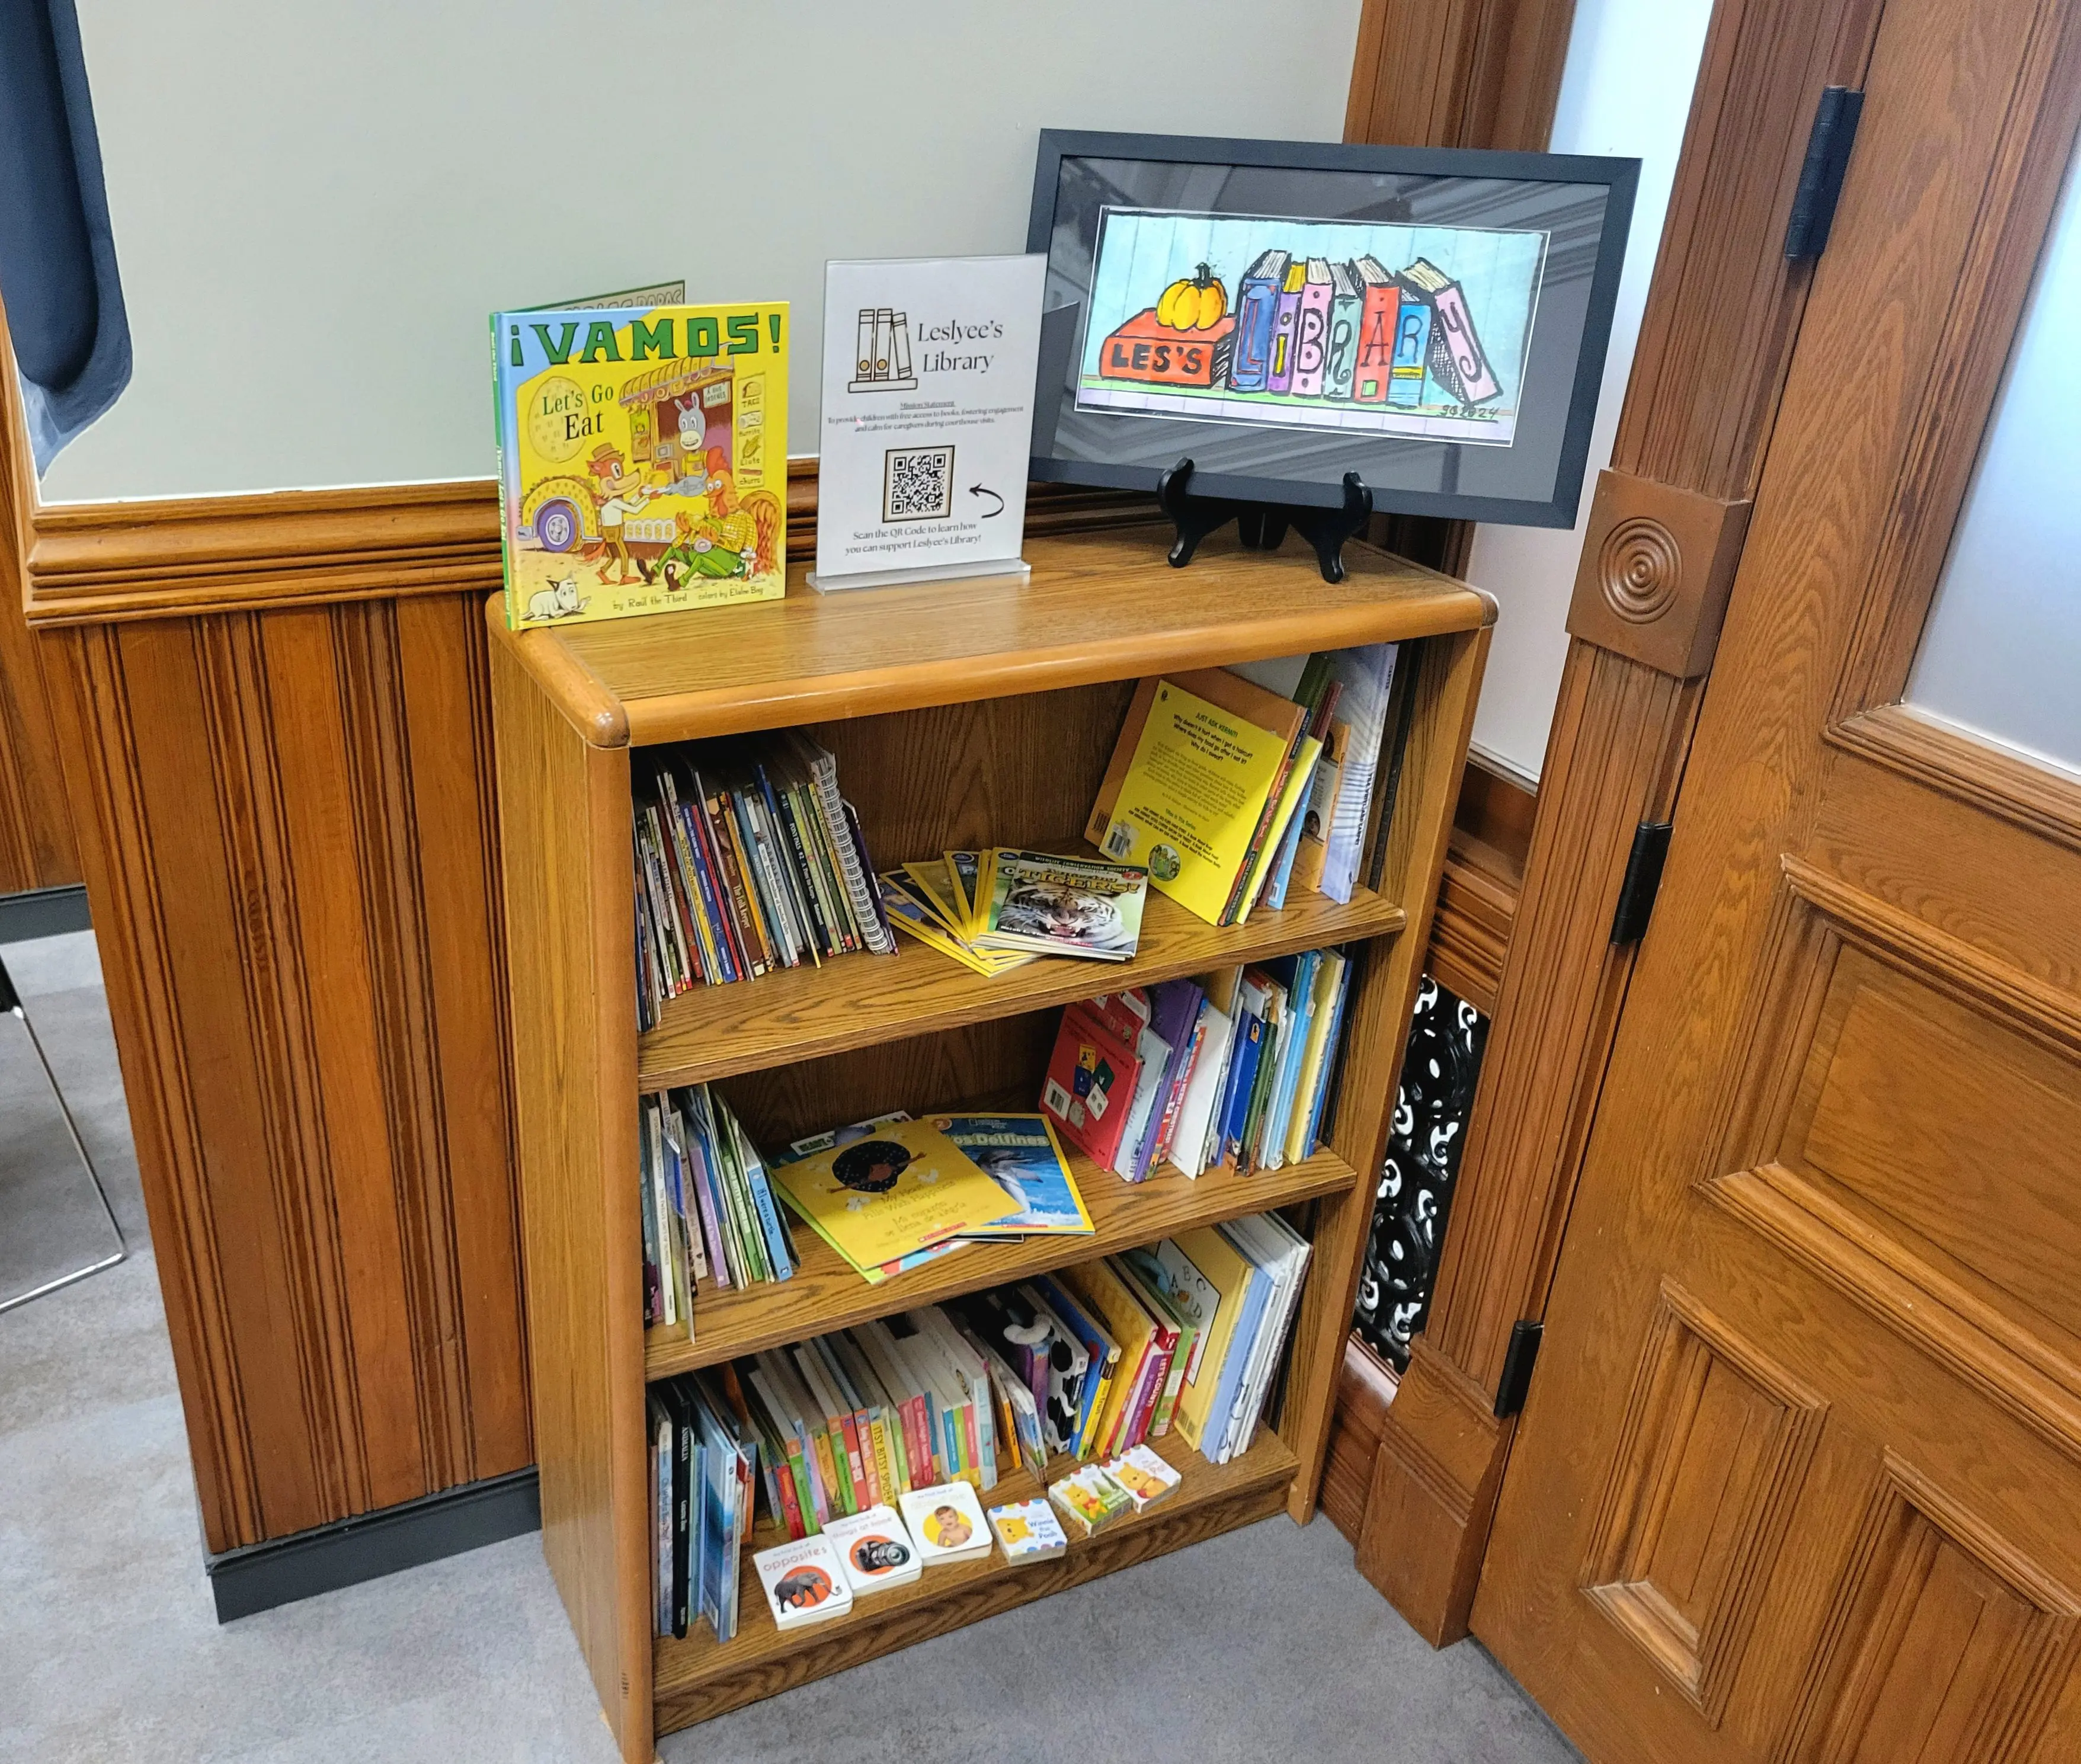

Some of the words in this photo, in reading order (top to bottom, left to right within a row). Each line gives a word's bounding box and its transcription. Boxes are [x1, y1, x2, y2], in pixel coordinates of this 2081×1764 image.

[510, 312, 782, 366] ¡VAMOS!
[918, 319, 1003, 344] Leslyee's
[923, 351, 995, 374] Library
[1110, 341, 1204, 374] LES'S
[543, 390, 583, 415] Let's
[591, 384, 614, 404] Go
[900, 402, 921, 410] Mission
[924, 401, 955, 409] Statement
[564, 411, 604, 441] Eat
[853, 530, 873, 540] Scan
[875, 529, 889, 538] the
[890, 527, 903, 538] QR
[904, 525, 926, 536] Code
[928, 525, 936, 533] to
[938, 523, 960, 533] learn
[961, 521, 977, 532] how
[845, 546, 862, 556] you
[863, 543, 878, 552] can
[879, 540, 911, 553] support
[913, 536, 949, 548] Leslyee's
[950, 534, 981, 546] Library!
[1195, 712, 1209, 723] JUST
[1207, 718, 1219, 728] ASK
[1189, 741, 1200, 750] Why
[1018, 866, 1140, 896] TIGERS!
[732, 884, 743, 897] The
[738, 908, 752, 929] Keeper
[950, 1135, 973, 1146] os
[1171, 1273, 1179, 1289] A
[870, 1425, 886, 1445] ITSY
[874, 1447, 891, 1471] BITSY
[877, 1472, 897, 1502] SPIDER
[762, 1544, 828, 1572] opposites
